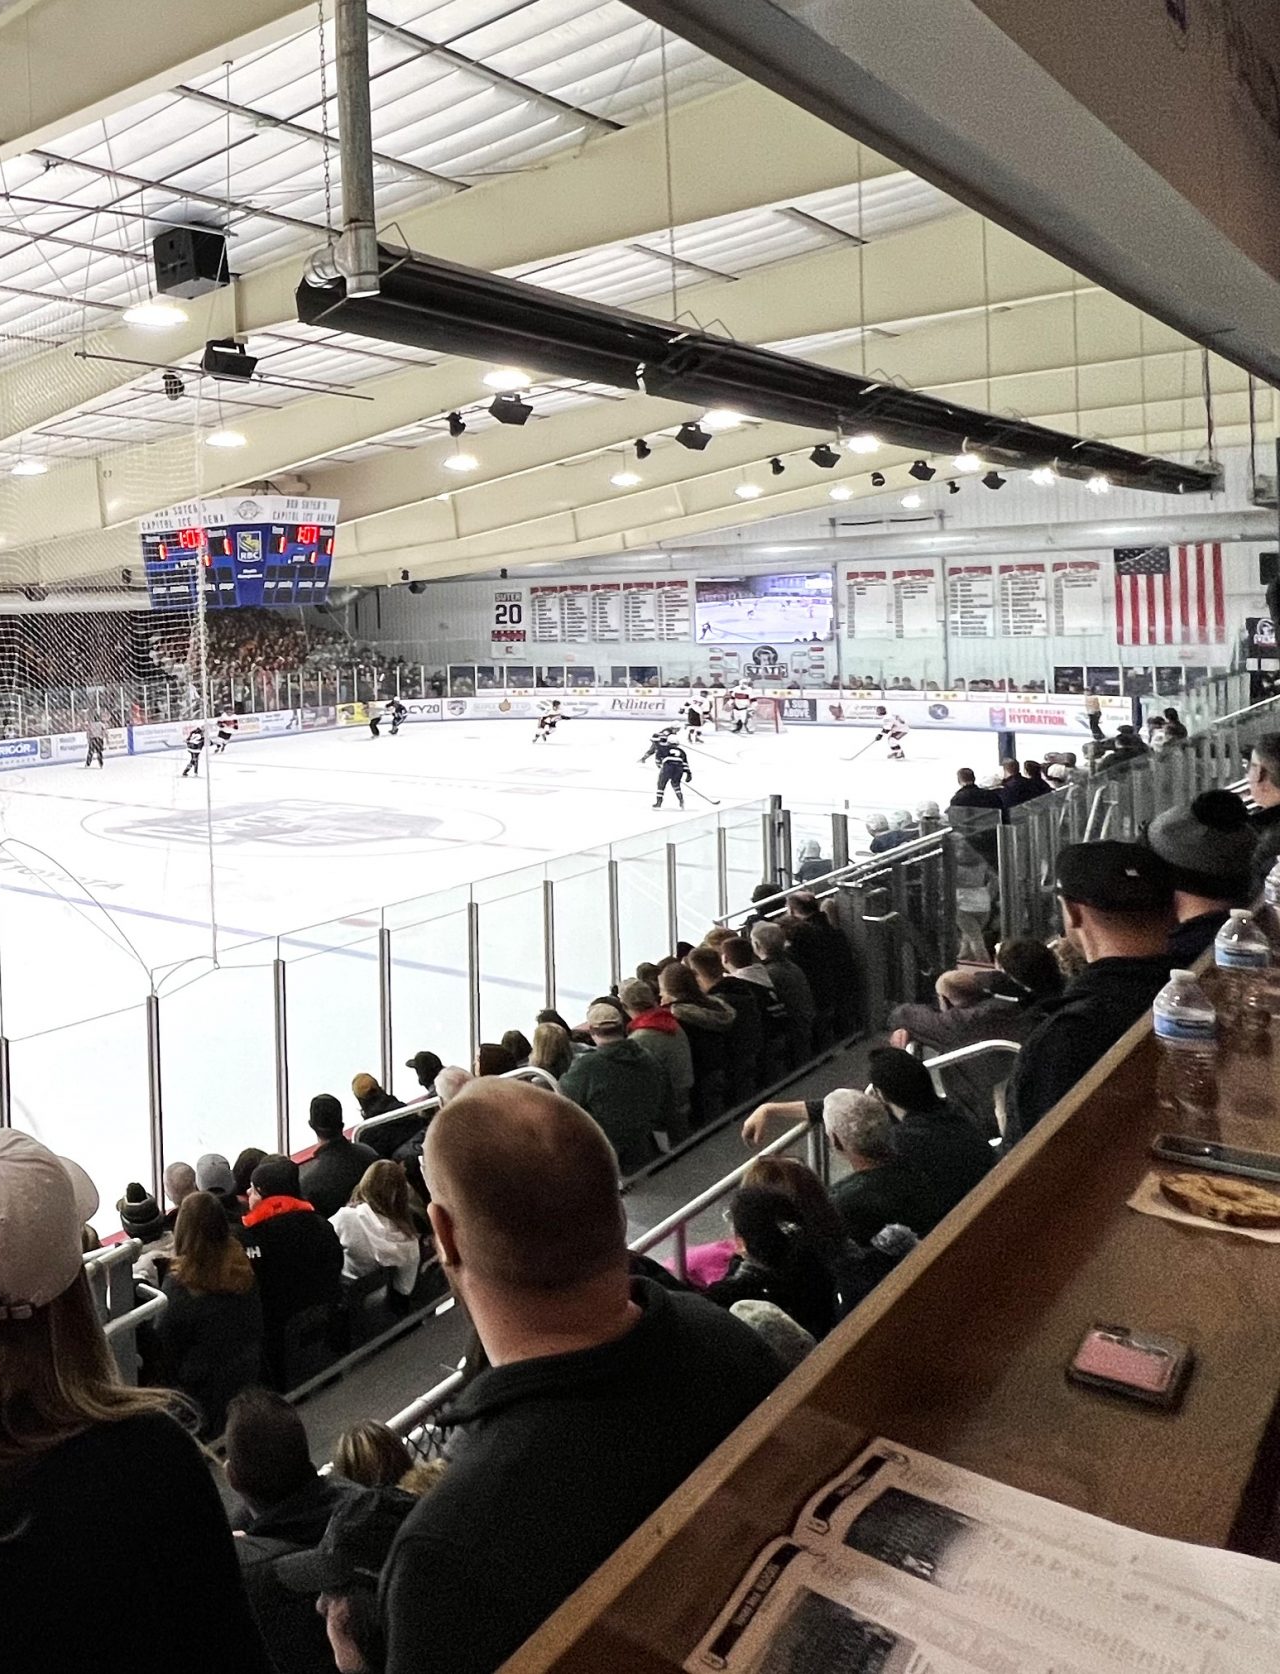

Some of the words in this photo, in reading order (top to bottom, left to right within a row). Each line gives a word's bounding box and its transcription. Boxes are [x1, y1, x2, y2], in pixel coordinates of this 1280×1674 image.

[240, 552, 260, 561] RBC
[496, 592, 522, 602] SUTER
[496, 604, 522, 624] 20
[611, 698, 666, 710] Pellitteri
